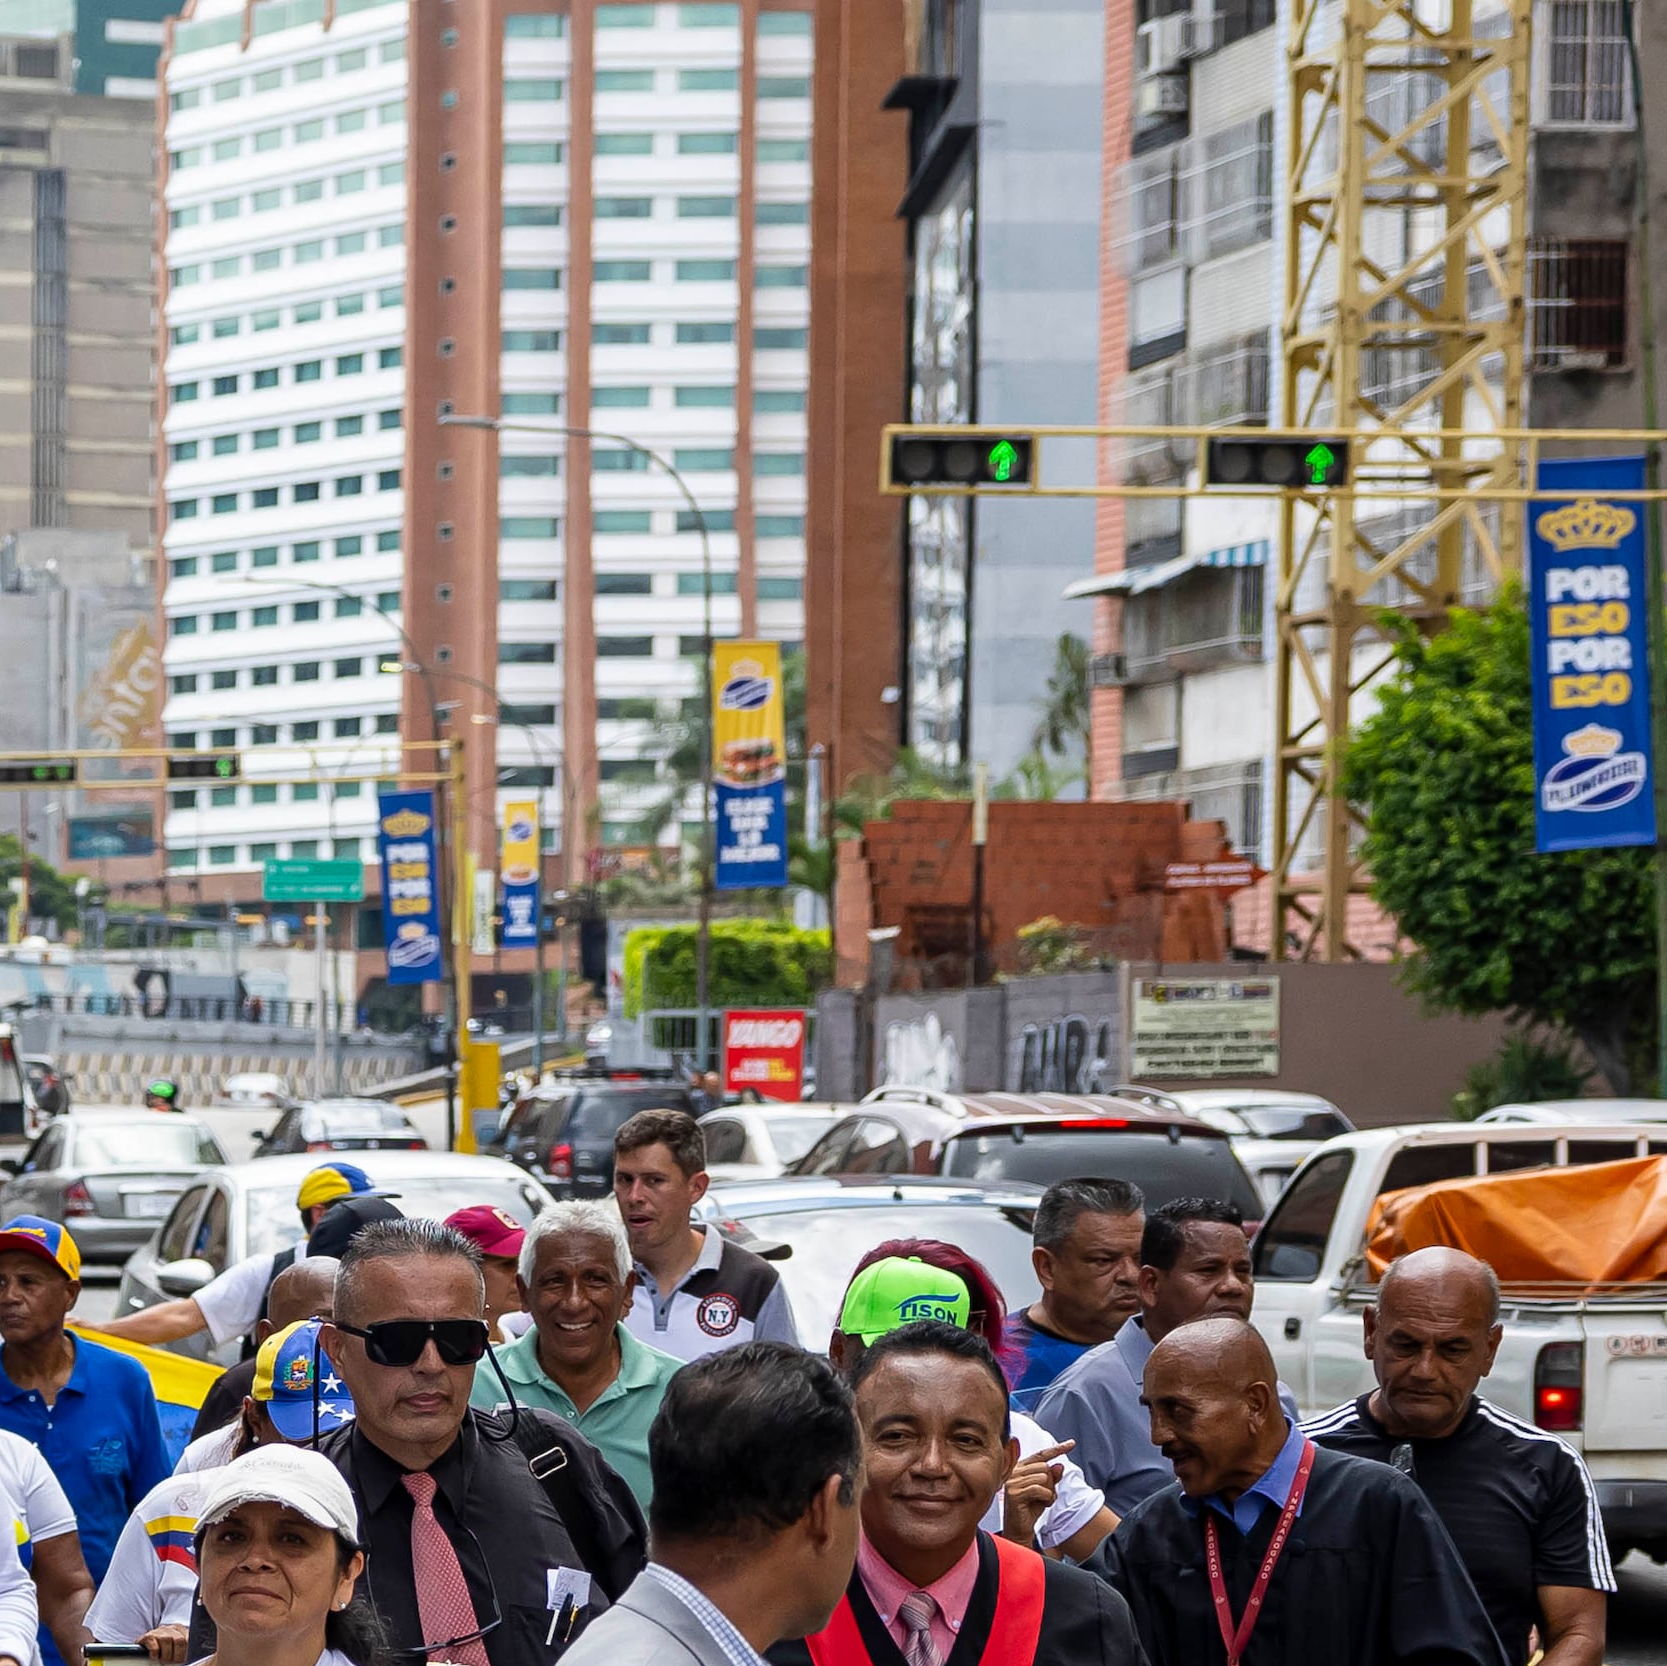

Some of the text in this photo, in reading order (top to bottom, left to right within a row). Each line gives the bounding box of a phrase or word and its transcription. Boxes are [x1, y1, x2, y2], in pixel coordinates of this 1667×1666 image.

[1545, 565, 1631, 602] POR
[1548, 601, 1630, 638] ESO
[1547, 637, 1632, 673] POR
[1550, 672, 1632, 709] ESO
[708, 1309, 729, 1323] N.Y
[900, 1303, 957, 1324] TISON
